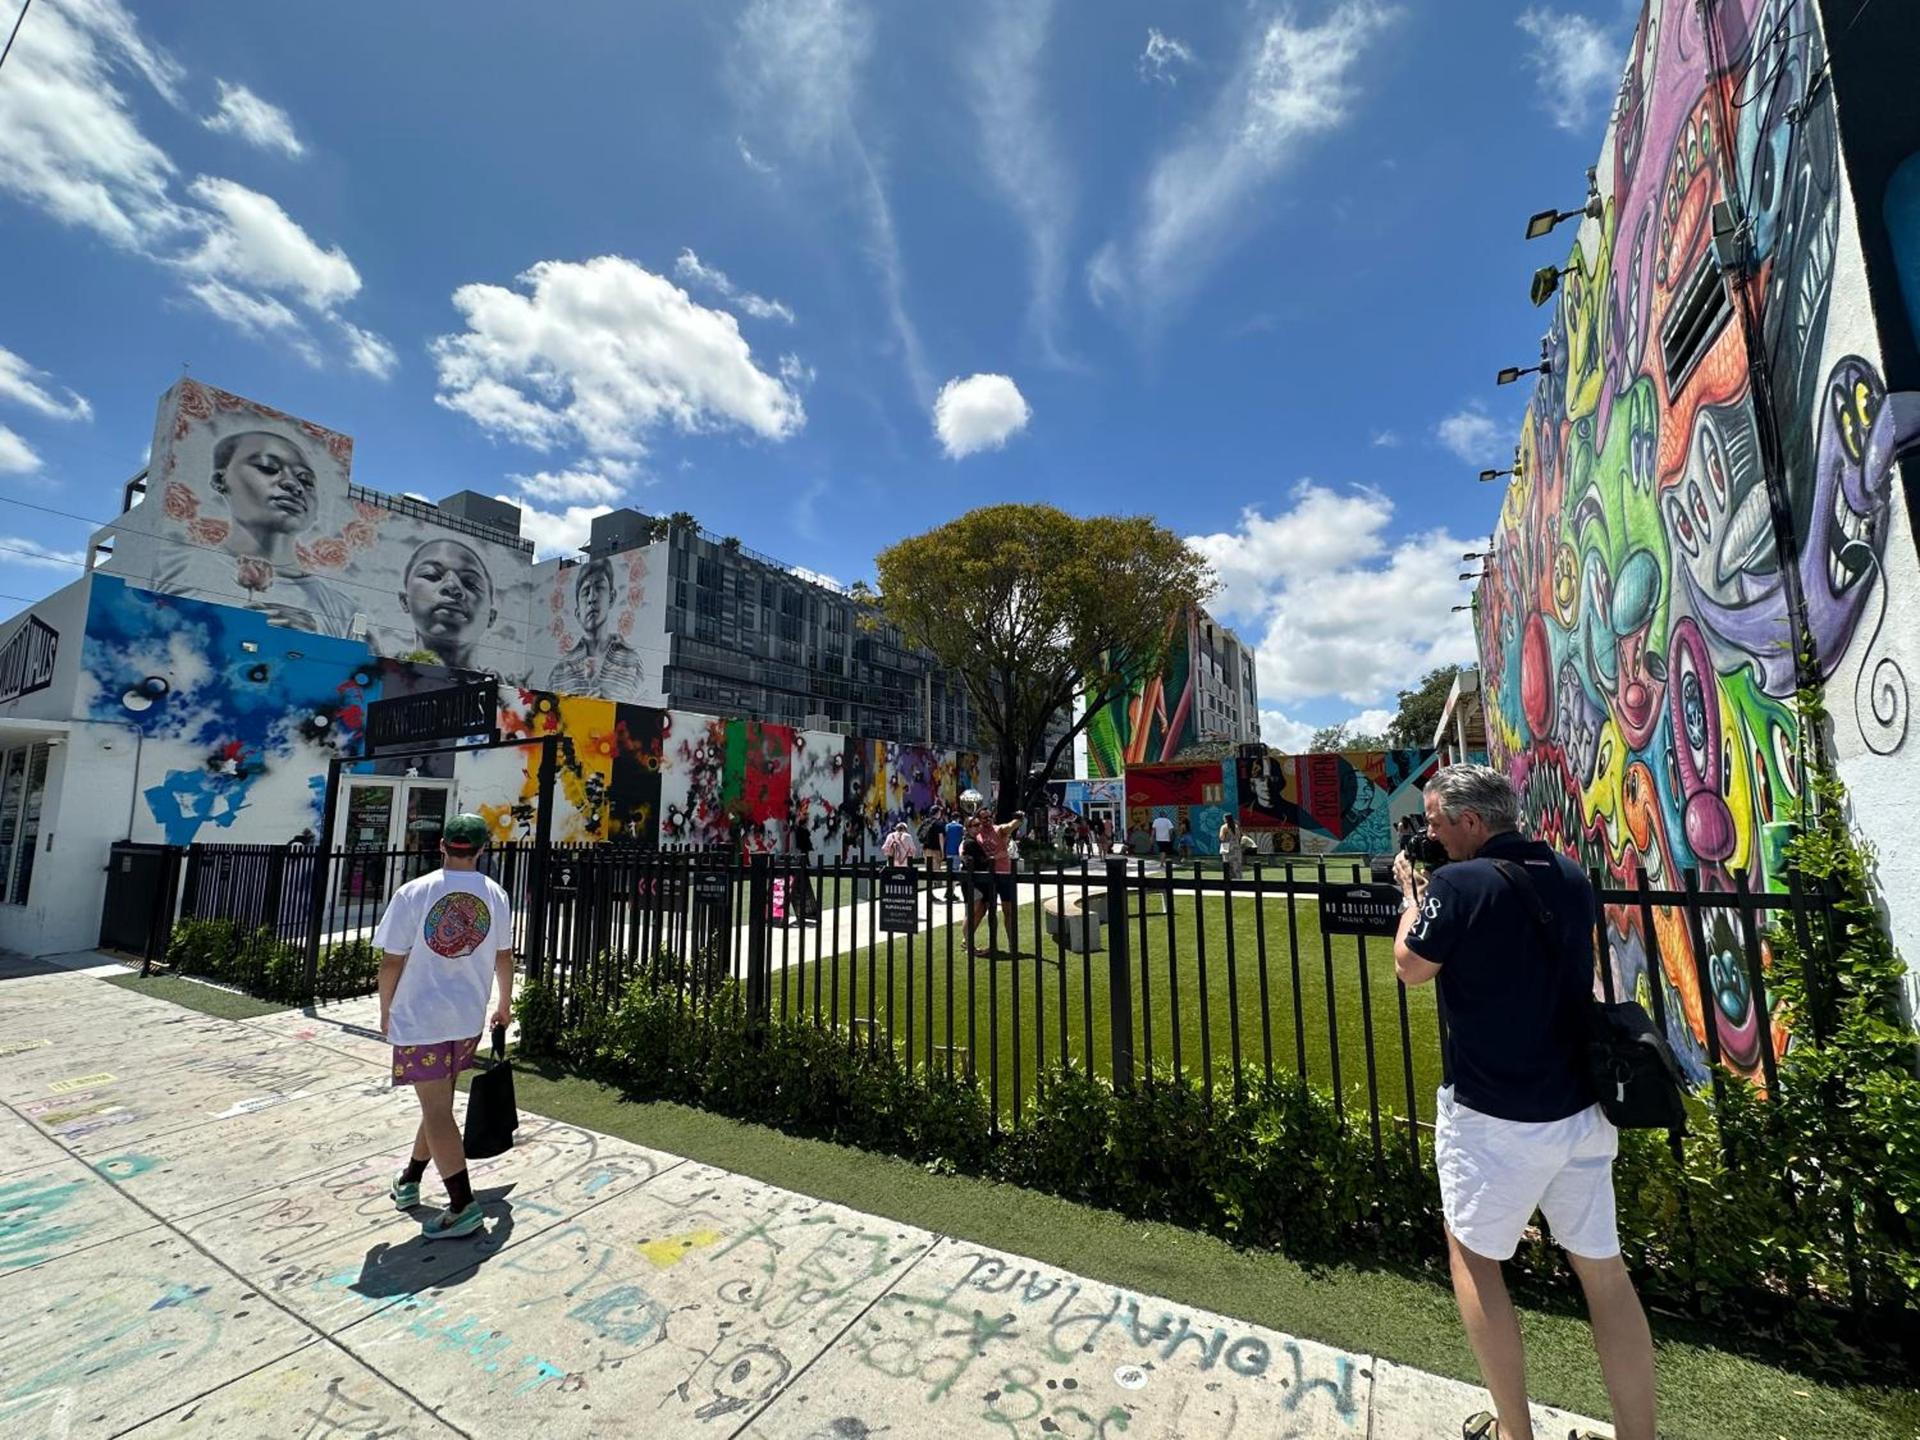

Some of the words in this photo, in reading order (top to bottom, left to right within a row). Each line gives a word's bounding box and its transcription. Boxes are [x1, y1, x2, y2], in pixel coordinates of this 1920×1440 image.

[1314, 790, 1338, 817] EYES
[1325, 902, 1336, 913] NO
[1341, 903, 1398, 916] SOLICITING
[1338, 915, 1365, 924] THANK
[1369, 916, 1386, 925] YOU
